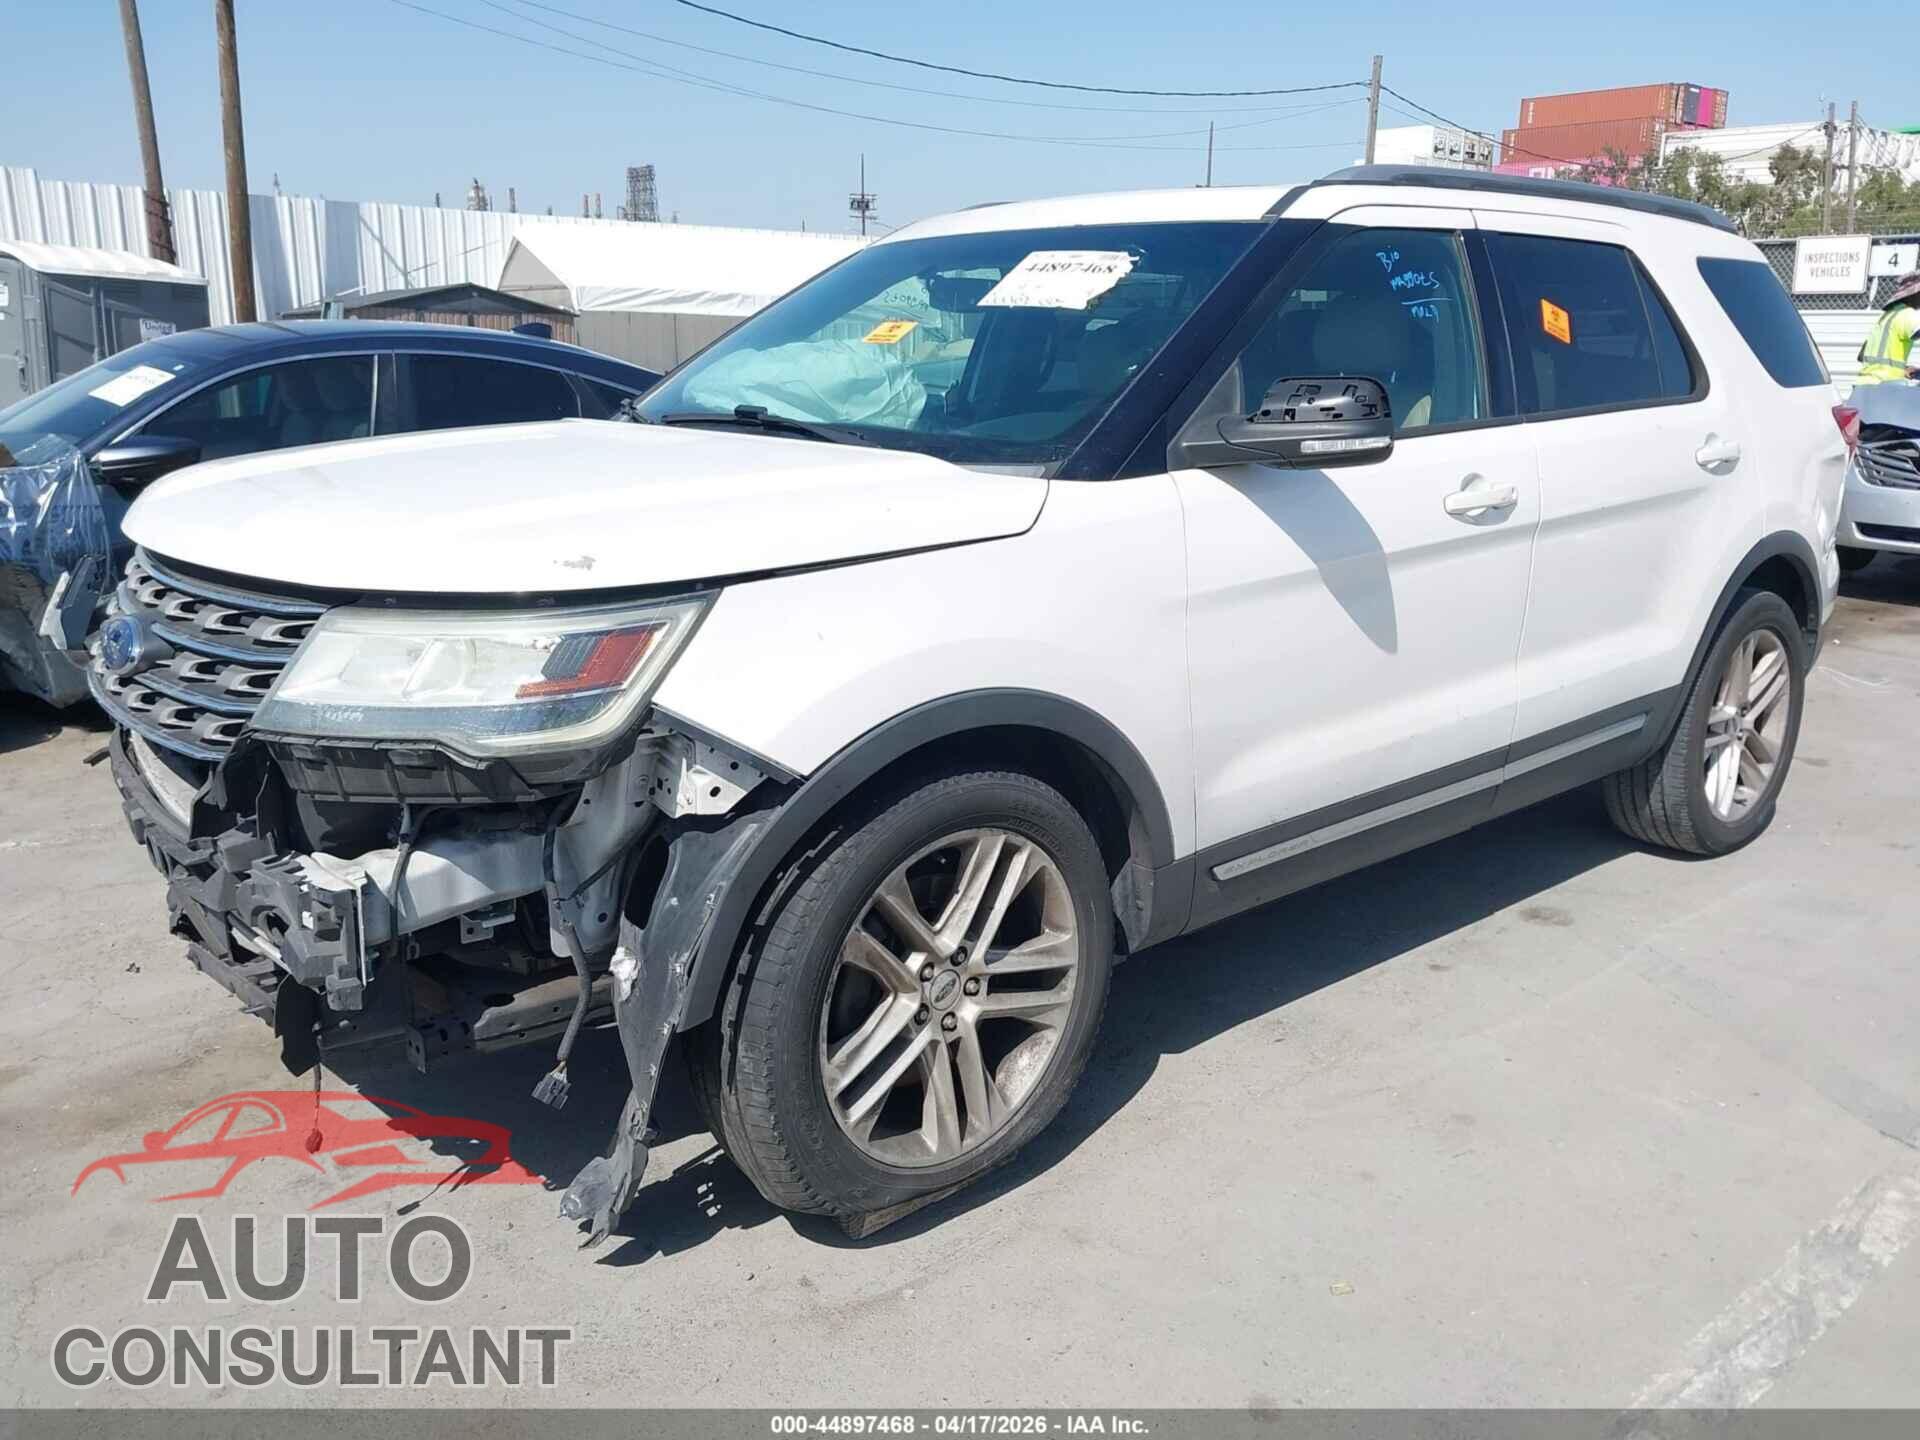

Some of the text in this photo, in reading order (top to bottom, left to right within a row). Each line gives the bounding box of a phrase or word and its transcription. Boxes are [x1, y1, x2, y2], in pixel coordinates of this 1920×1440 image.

[1804, 251, 1861, 264] INSPECTIONS
[1888, 252, 1899, 267] 4
[1025, 261, 1118, 274] 44897468
[1809, 266, 1851, 278] VEHICLES
